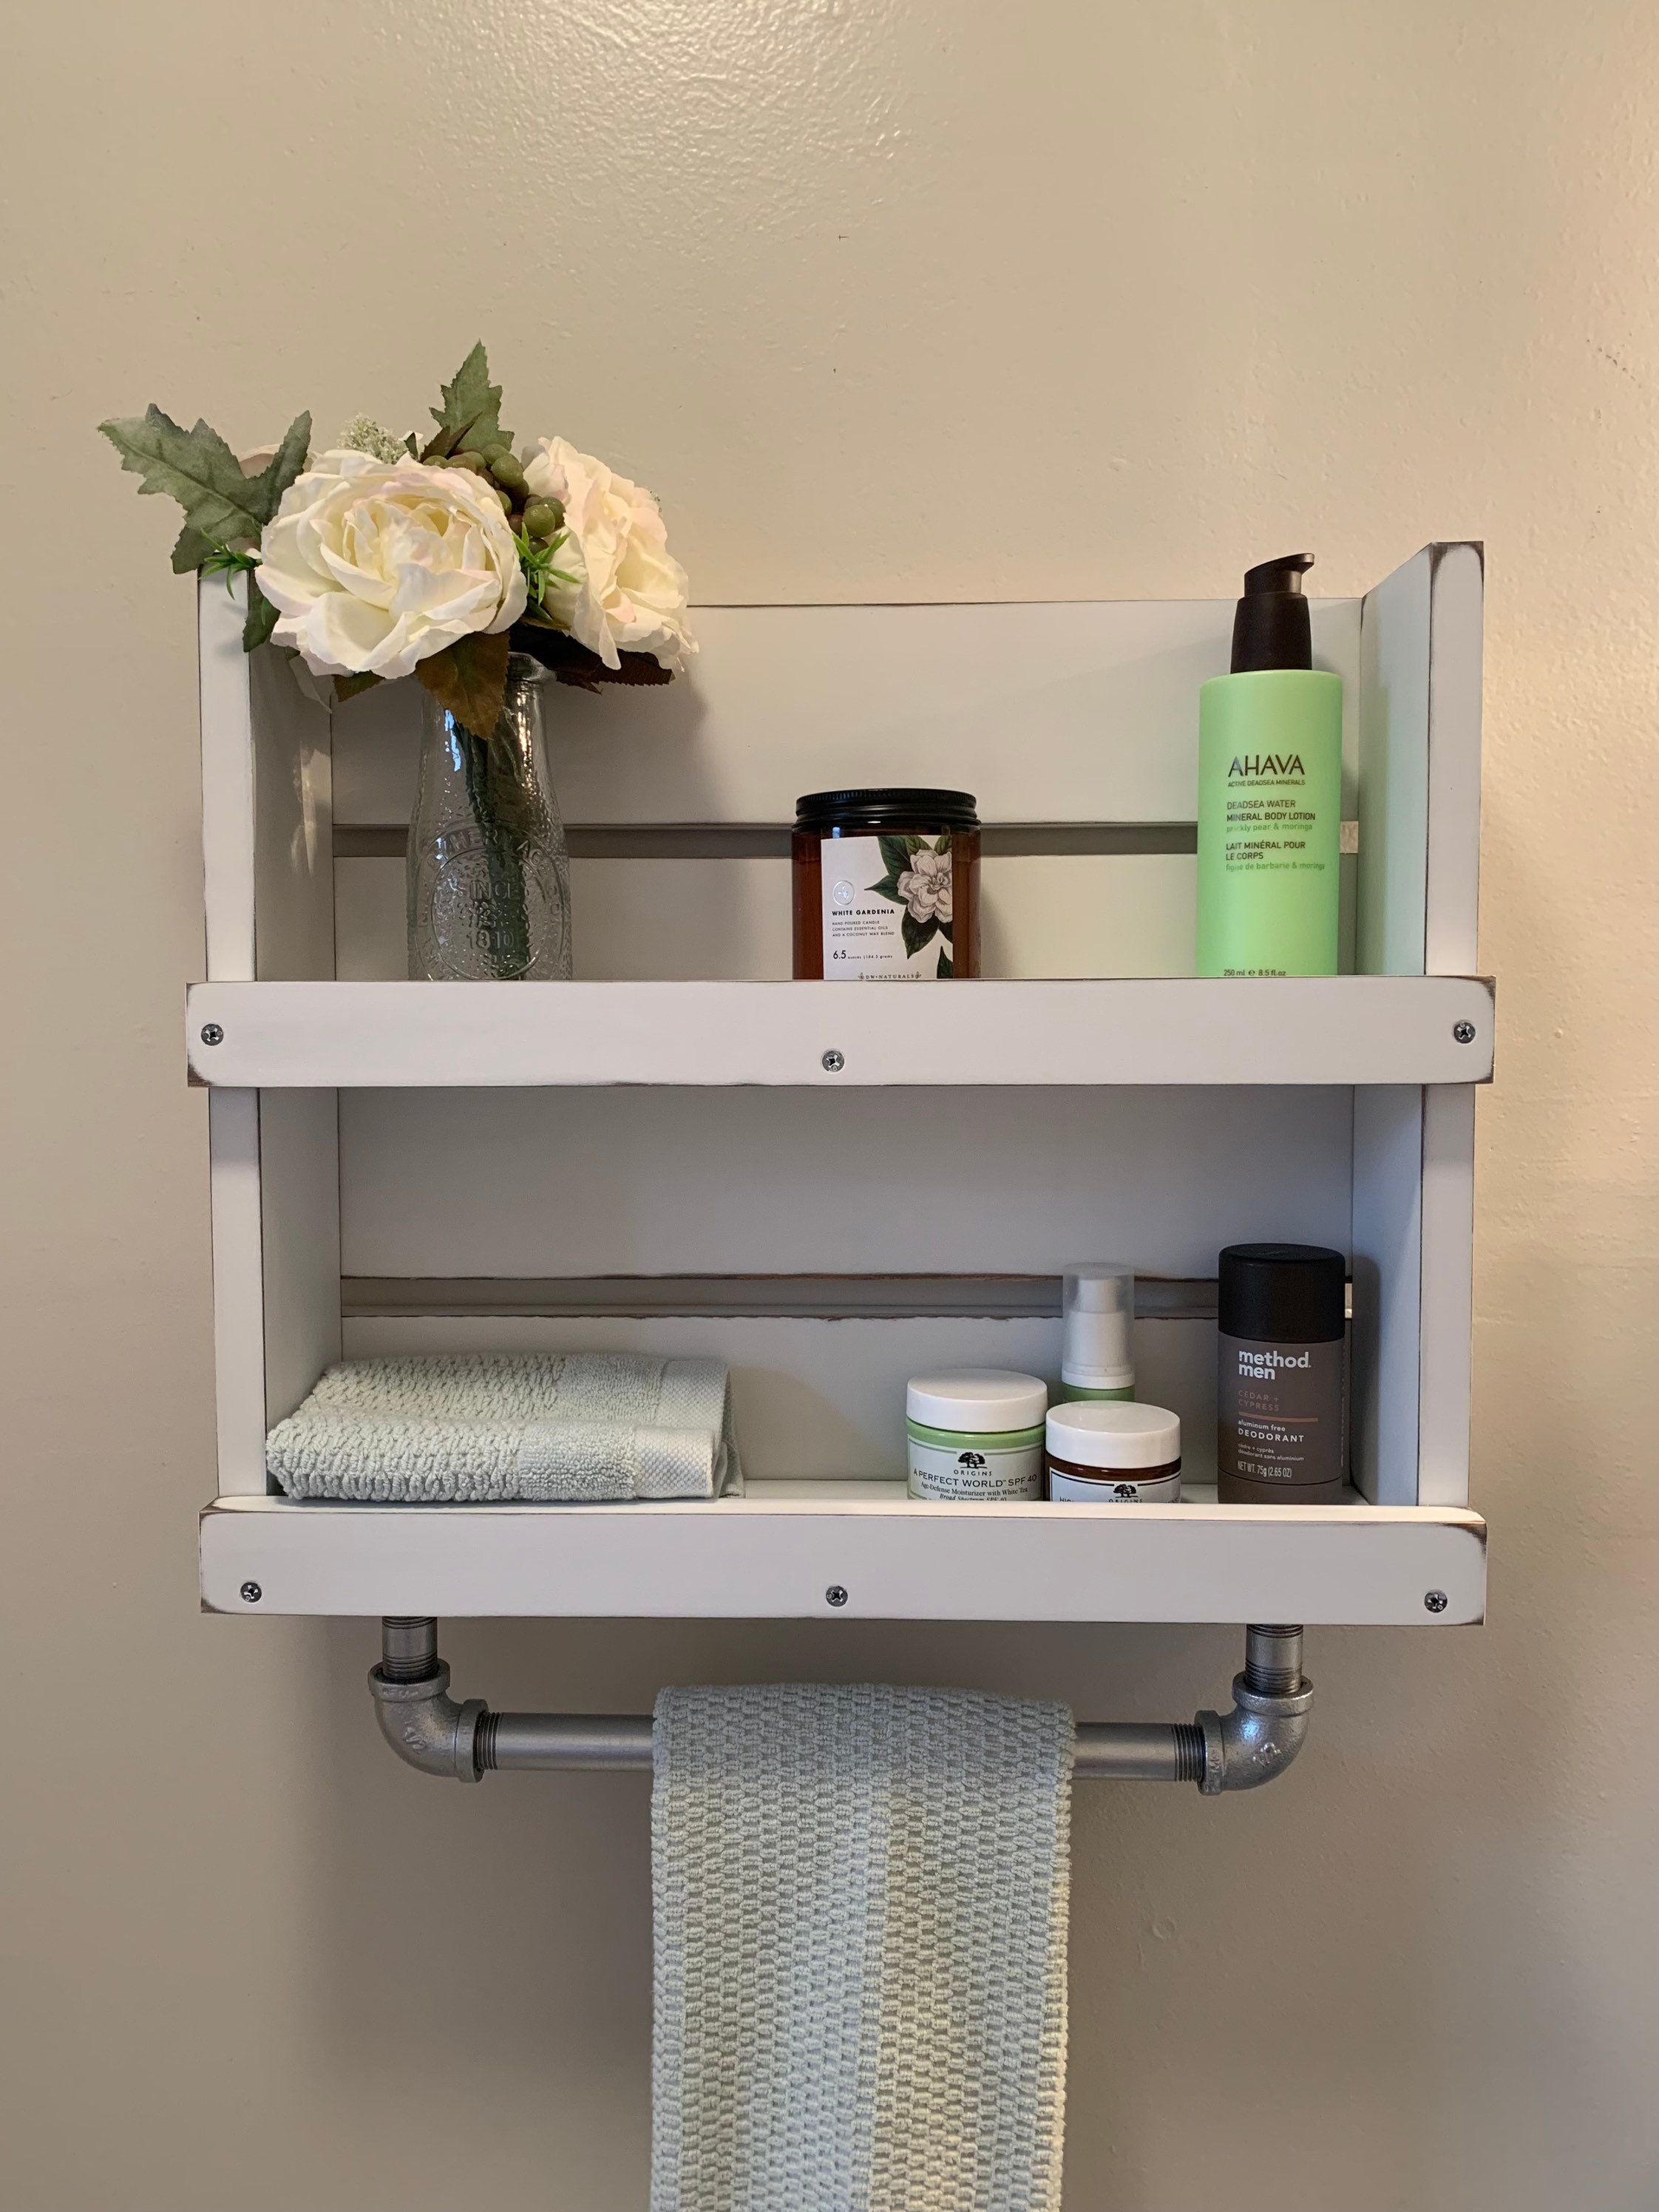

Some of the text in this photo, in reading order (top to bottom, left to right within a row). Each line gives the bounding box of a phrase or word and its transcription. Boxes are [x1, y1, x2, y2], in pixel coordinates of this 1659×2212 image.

[1228, 754, 1306, 777] AHAVA
[1227, 799, 1296, 810] DEADSEA WATER
[1227, 812, 1316, 822] MINERAL BODY LOTION
[1253, 824, 1272, 832] pear
[1282, 823, 1313, 832] moringa
[1226, 840, 1306, 850] LAIT MINÉRAL POUR
[1226, 852, 1264, 861] LE CORPS
[1245, 863, 1254, 871] de
[1256, 861, 1290, 870] barbarie
[832, 949, 847, 960] 6.5
[1238, 1363, 1276, 1380] men
[1238, 1389, 1269, 1402] CEDAR
[1238, 1399, 1280, 1412] CYPRESS
[1238, 1419, 1286, 1432] aluminum free
[1238, 1427, 1305, 1442] DEODORANT
[1238, 1460, 1247, 1471] NET
[1257, 1465, 1267, 1477] 75g
[1268, 1466, 1283, 1478] (2.65
[1282, 1467, 1292, 1479] OZ)
[913, 1468, 918, 1476] A
[918, 1470, 960, 1486] PERFECT
[1008, 1478, 1025, 1486] SPF
[1027, 1473, 1037, 1483] 40
[920, 1481, 951, 1493] Age-Defense
[951, 1488, 985, 1496] Moisturizer
[1002, 1487, 1018, 1496] White
[939, 1493, 957, 1501] Broad
